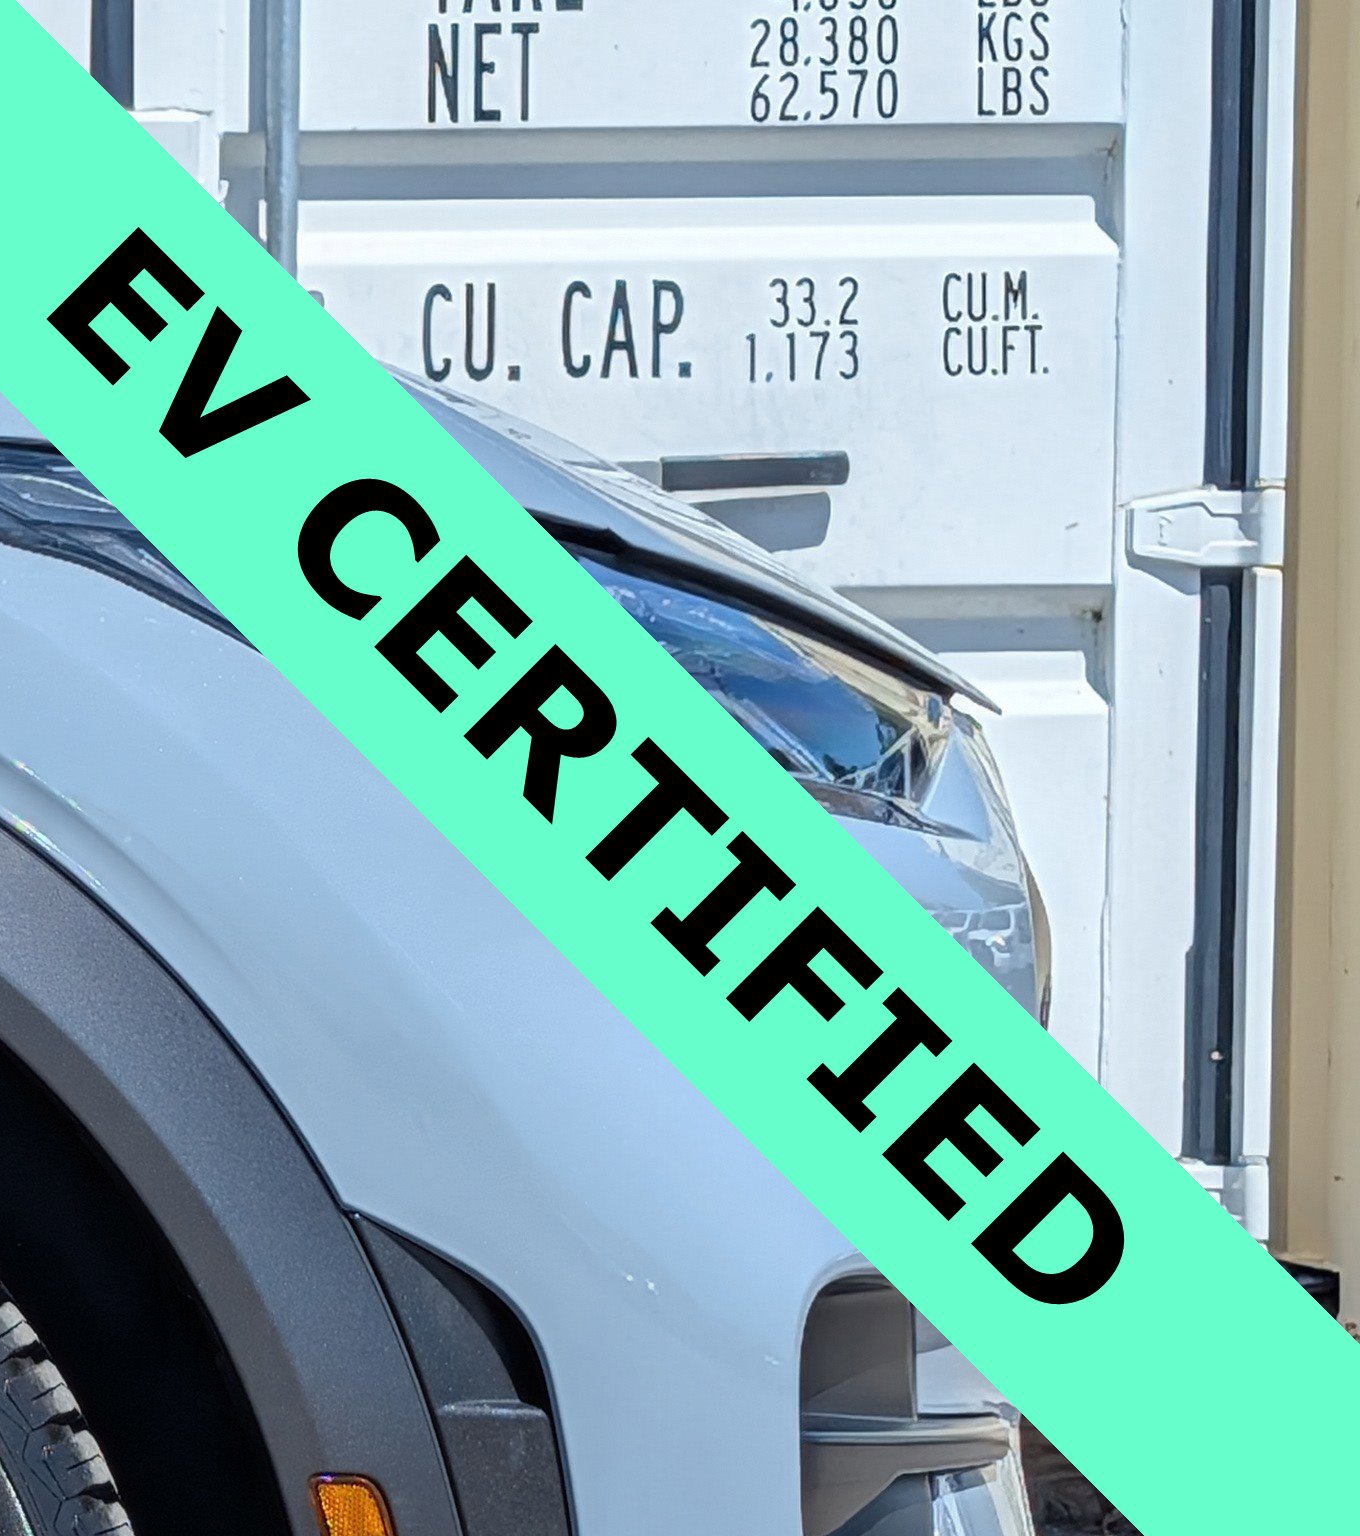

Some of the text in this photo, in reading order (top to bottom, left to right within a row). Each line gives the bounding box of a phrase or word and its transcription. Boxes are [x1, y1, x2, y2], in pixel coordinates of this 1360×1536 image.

[977, 11, 1049, 62] KGS
[428, 22, 539, 123] NET
[977, 66, 1049, 116] LBS
[769, 270, 1039, 328] 33.2 CU.M.
[423, 279, 692, 382] CU. CAP.
[942, 324, 1049, 376] CU.FT.
